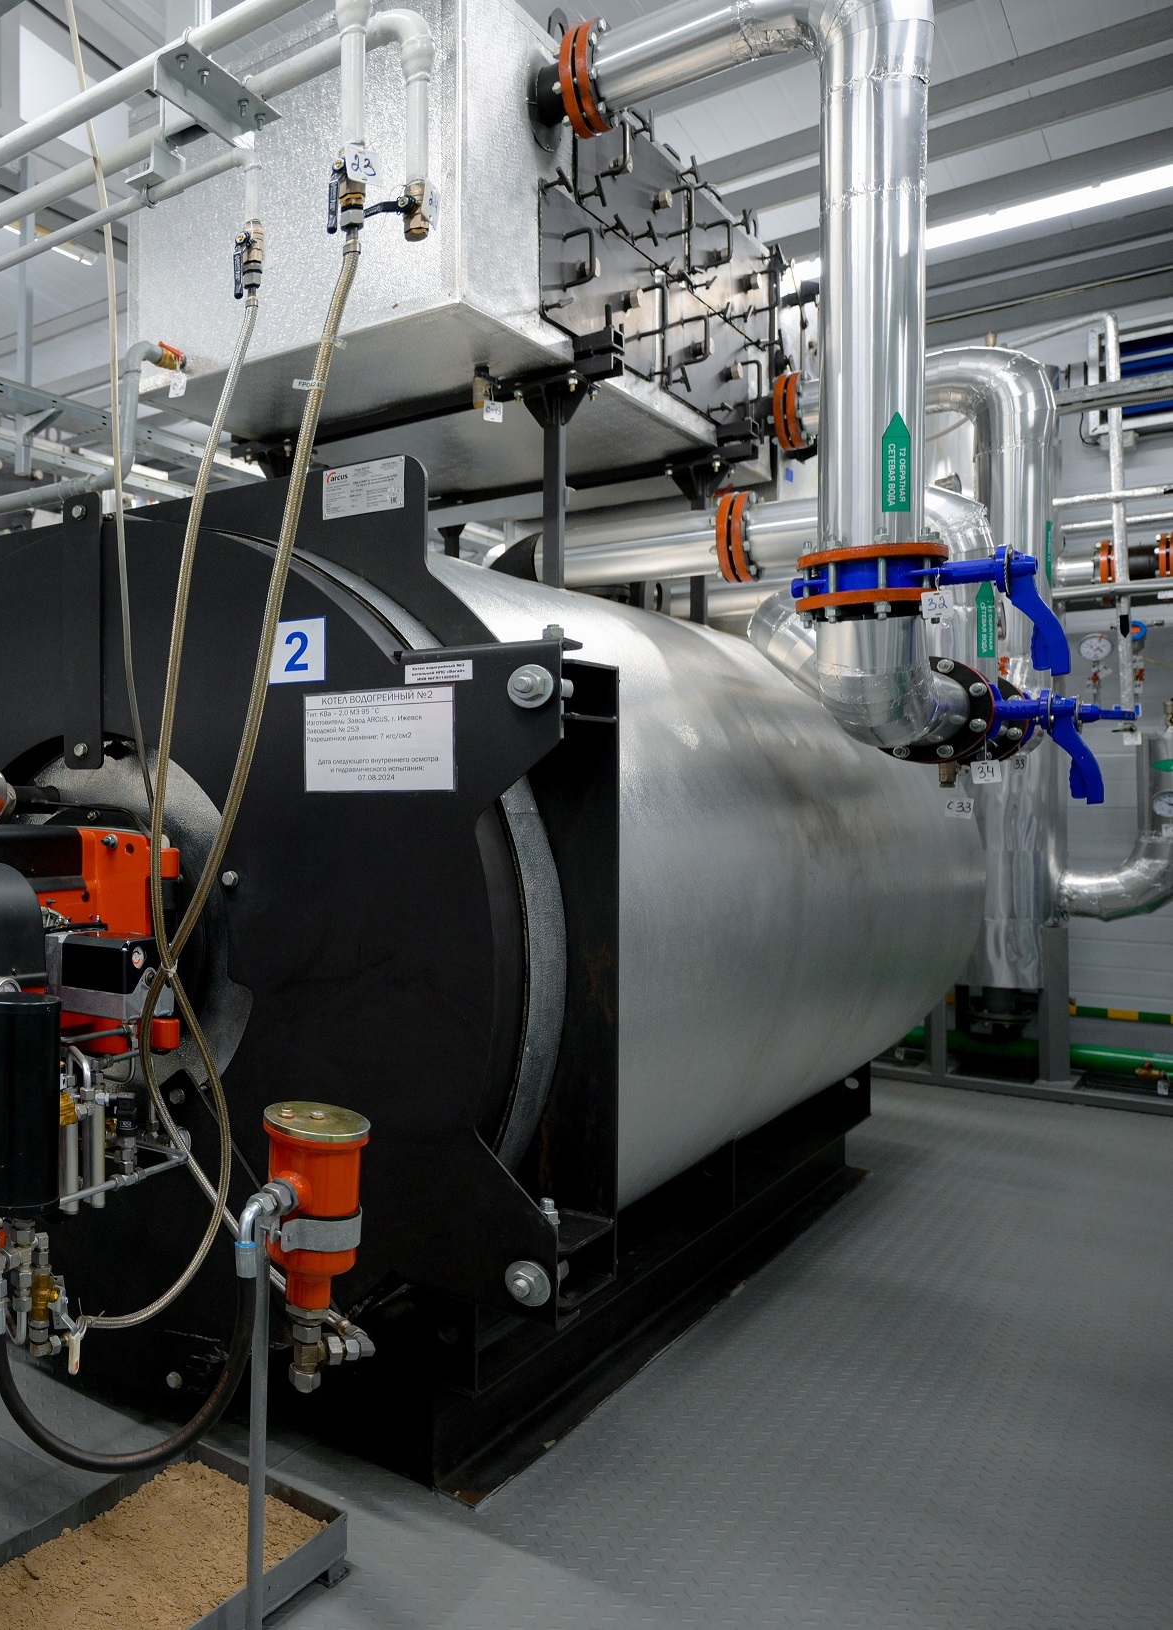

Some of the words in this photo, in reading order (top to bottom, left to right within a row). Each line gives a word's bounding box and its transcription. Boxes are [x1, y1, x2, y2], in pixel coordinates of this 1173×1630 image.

[351, 154, 376, 176] 23
[888, 443, 896, 482] СЕТЕВАЯ
[330, 474, 349, 483] arcus
[899, 459, 907, 502] ОБРАТНАЯ
[888, 484, 896, 507] ВОДА
[927, 596, 948, 611] 32
[284, 632, 309, 672] 2
[321, 696, 348, 706] КОТЕЛ
[349, 691, 415, 704] ВОДОГРЕЙНЫЙ
[417, 691, 433, 699] №2
[347, 717, 366, 725] Завод
[348, 734, 379, 742] давление:
[317, 758, 332, 766] Дата
[332, 757, 370, 765] следующего
[370, 756, 410, 764] внутреннего
[335, 766, 387, 774] гидравлического
[387, 765, 425, 773] испытания:
[977, 765, 995, 779] 34
